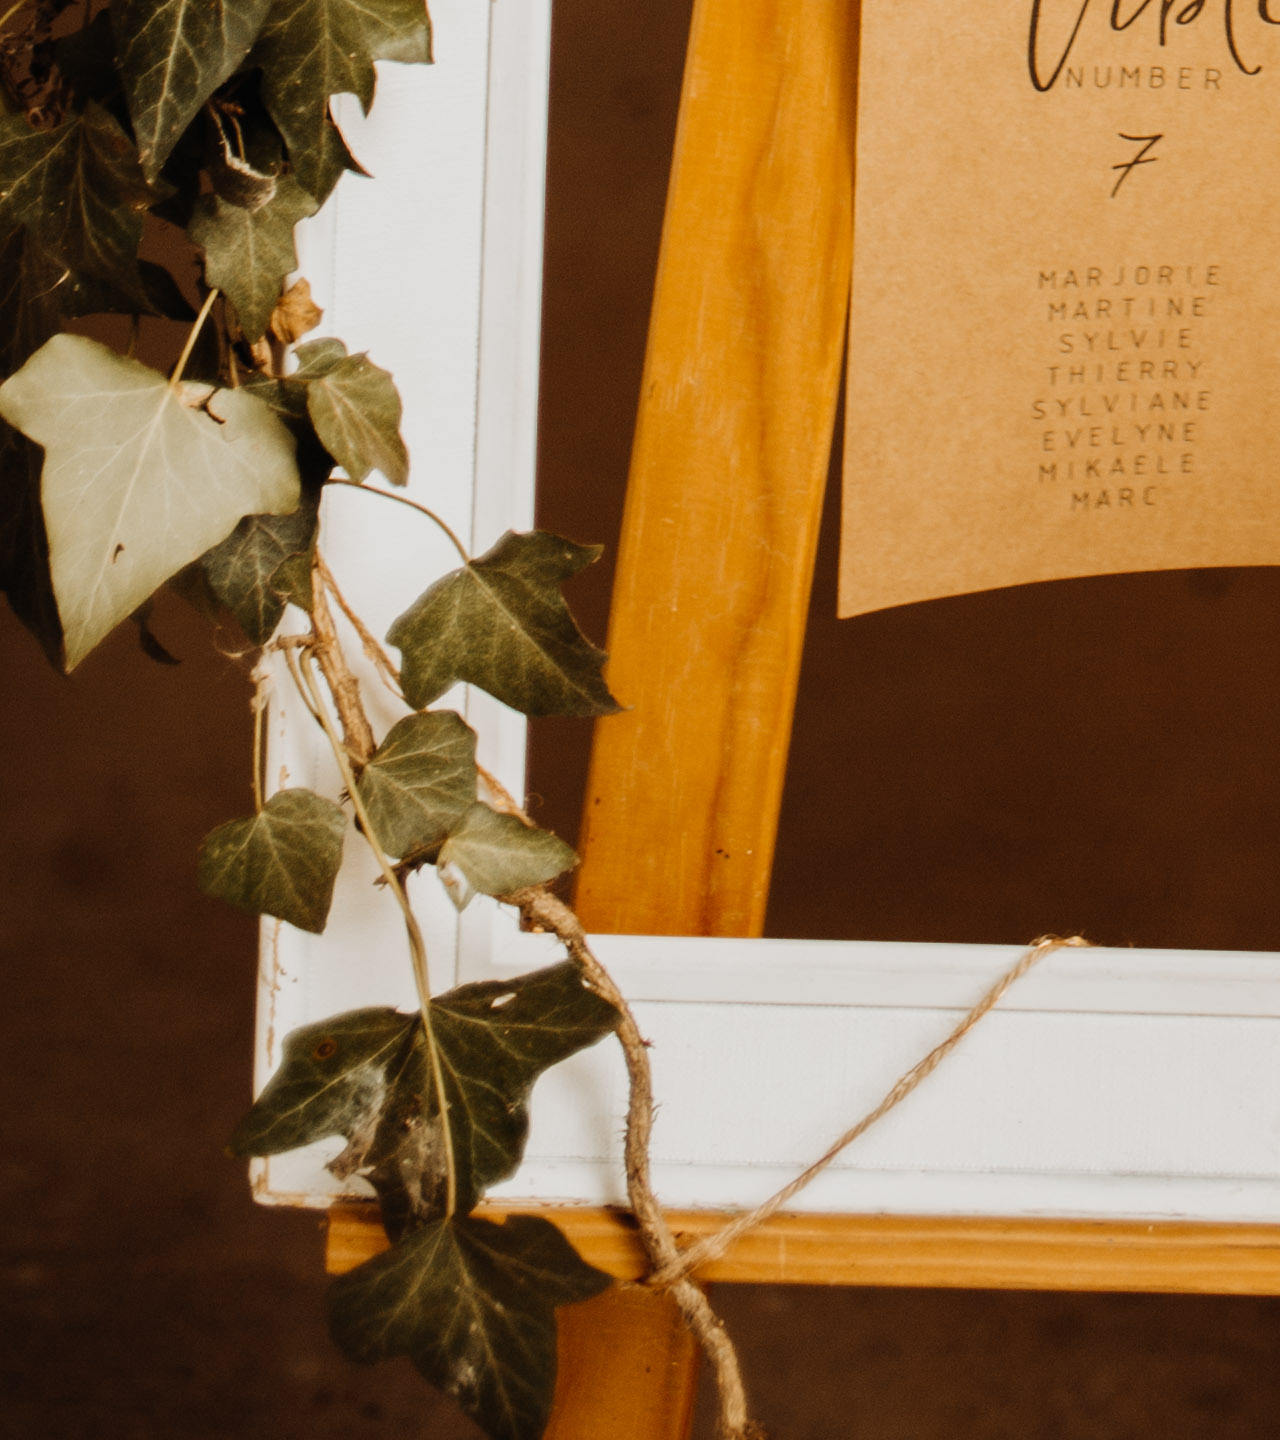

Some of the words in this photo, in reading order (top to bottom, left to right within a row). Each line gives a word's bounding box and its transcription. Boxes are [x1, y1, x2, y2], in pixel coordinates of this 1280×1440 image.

[1064, 65, 1223, 91] NUMBER
[1111, 132, 1163, 198] 7
[1038, 264, 1221, 289] MARJORIE
[1048, 296, 1206, 321] MARTINE
[1059, 328, 1191, 353] SYLVIE
[1048, 359, 1202, 385] THIERRY
[1032, 390, 1211, 420] SYLVIANE
[1042, 421, 1197, 451] EVELYNE
[1038, 452, 1193, 483] MIKAELE
[1072, 485, 1157, 509] MARC
